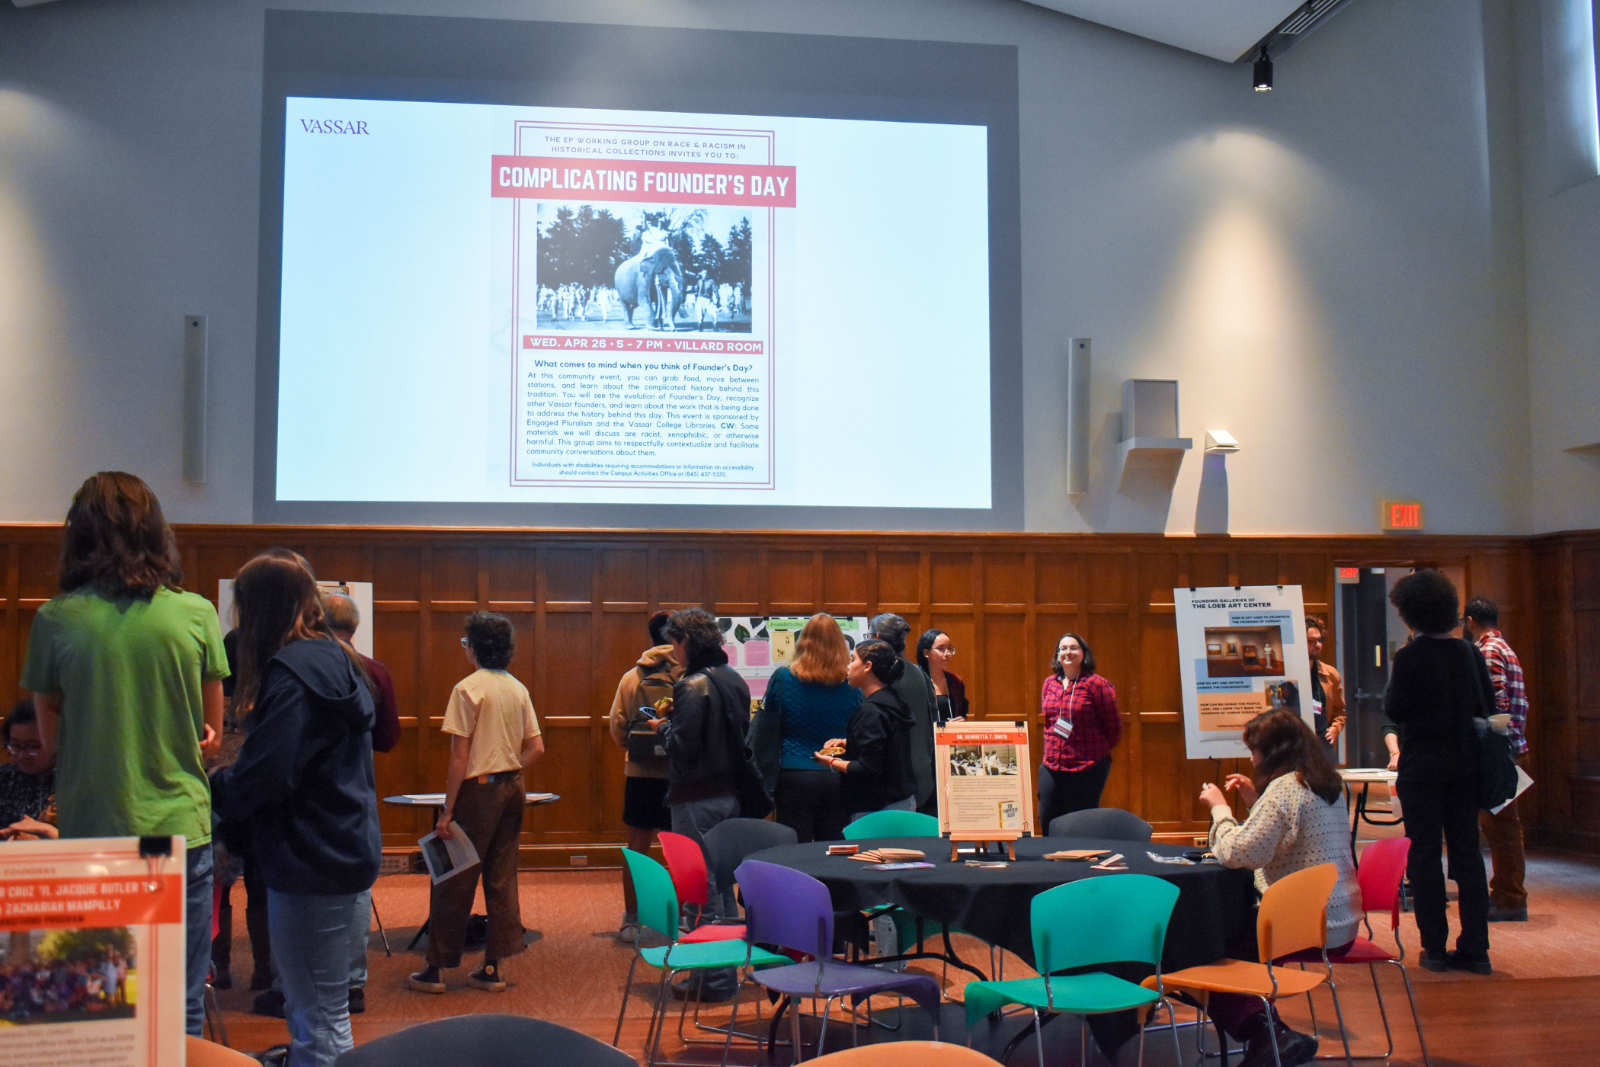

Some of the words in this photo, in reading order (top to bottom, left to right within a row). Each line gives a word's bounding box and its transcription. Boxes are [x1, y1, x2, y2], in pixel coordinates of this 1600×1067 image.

[300, 119, 370, 135] VASSAR
[578, 138, 617, 146] WORKING
[702, 142, 735, 150] RACISM
[552, 147, 602, 155] HISTORICAL
[606, 148, 666, 157] COLLECTIONS
[499, 166, 637, 192] COMPLICATING
[644, 171, 744, 195] FOUNDER'S
[751, 174, 789, 197] DAY
[530, 338, 560, 348] WED.
[564, 339, 588, 348] APR
[591, 340, 606, 349] 26
[616, 340, 624, 349] 5
[636, 341, 642, 350] 7
[646, 341, 662, 350] PM
[674, 342, 724, 352] VILLARD
[727, 343, 762, 352] ROOM
[534, 360, 557, 368] What
[587, 361, 596, 369] to
[598, 361, 617, 369] mind
[619, 361, 642, 370] when
[644, 364, 658, 372] you
[661, 362, 680, 370] think
[682, 362, 690, 370] of
[692, 362, 730, 371] Founder's
[732, 363, 753, 373] Day?
[1392, 504, 1420, 526] EXIT
